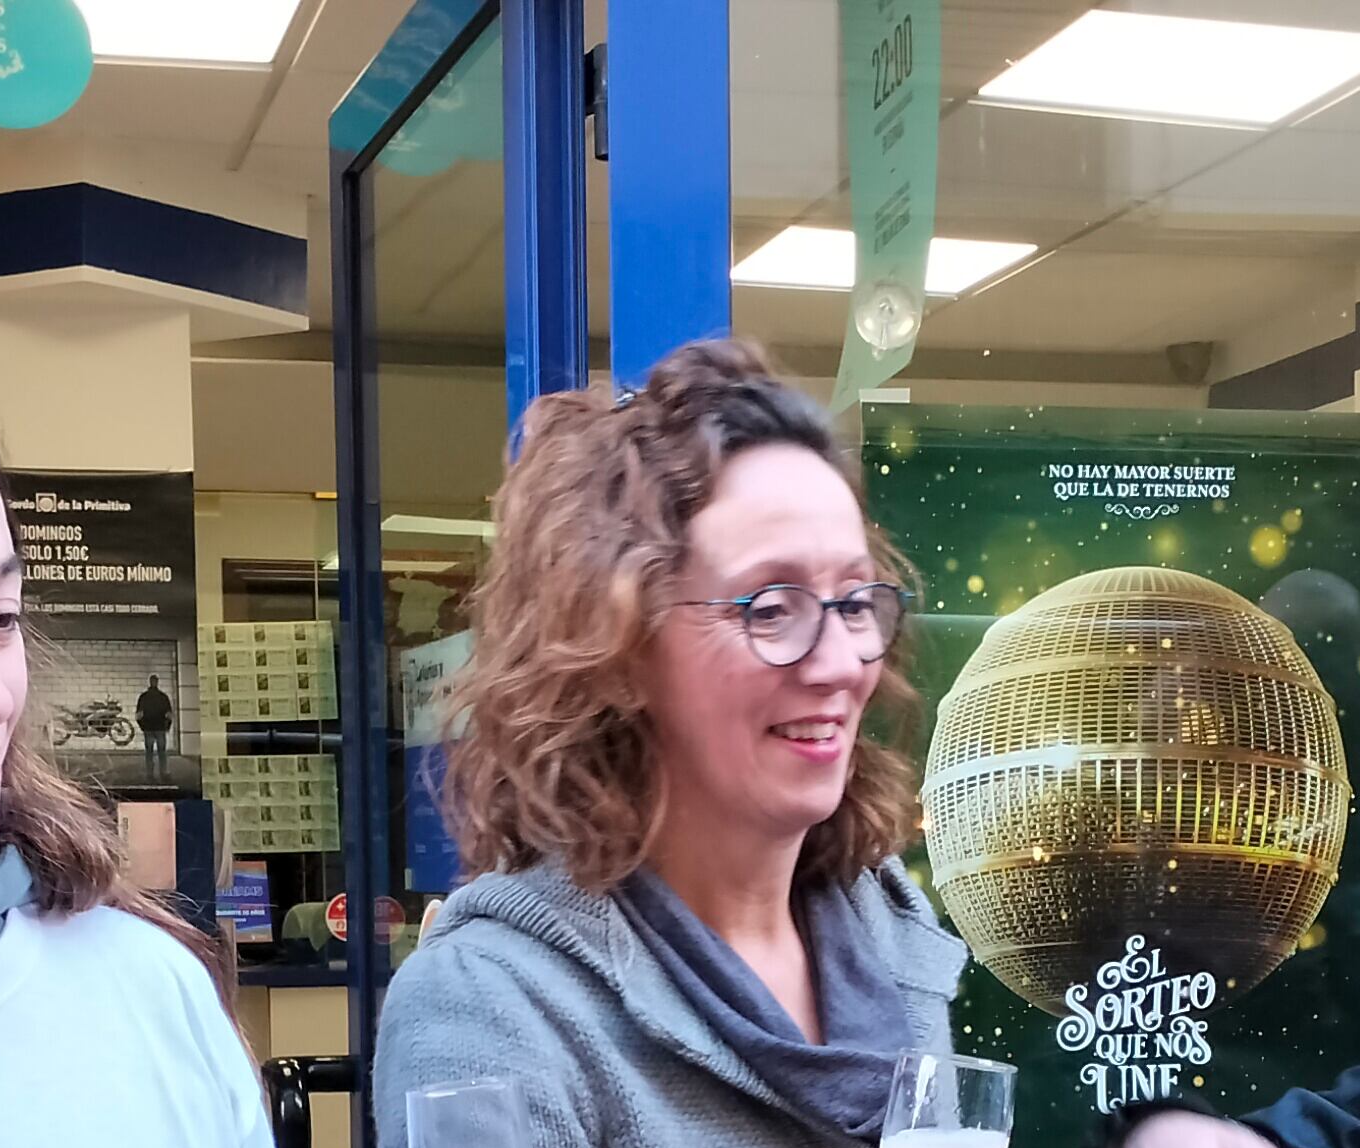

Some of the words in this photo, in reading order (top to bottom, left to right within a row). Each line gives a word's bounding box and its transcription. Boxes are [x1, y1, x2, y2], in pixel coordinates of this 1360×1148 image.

[1049, 464, 1073, 478] NO
[1077, 464, 1111, 479] HAY
[1113, 464, 1170, 480] MAYOR
[1173, 465, 1236, 480] SUERTE
[1053, 482, 1089, 500] QUE
[1092, 482, 1114, 497] LA
[1117, 482, 1140, 497] DE
[1142, 483, 1230, 498] TENERNOS
[10, 498, 35, 510] ordo
[57, 500, 71, 510] de
[72, 499, 82, 510] la
[84, 500, 132, 511] Primitiva
[55, 546, 89, 562] 1,50€
[67, 567, 82, 581] DE
[85, 567, 124, 581] EUROS
[127, 563, 172, 582] MÍNIMO
[1096, 934, 1167, 989] EL
[1056, 971, 1216, 1052] SORTEO
[1095, 1032, 1148, 1065] QUE
[1154, 1016, 1212, 1065] NOS
